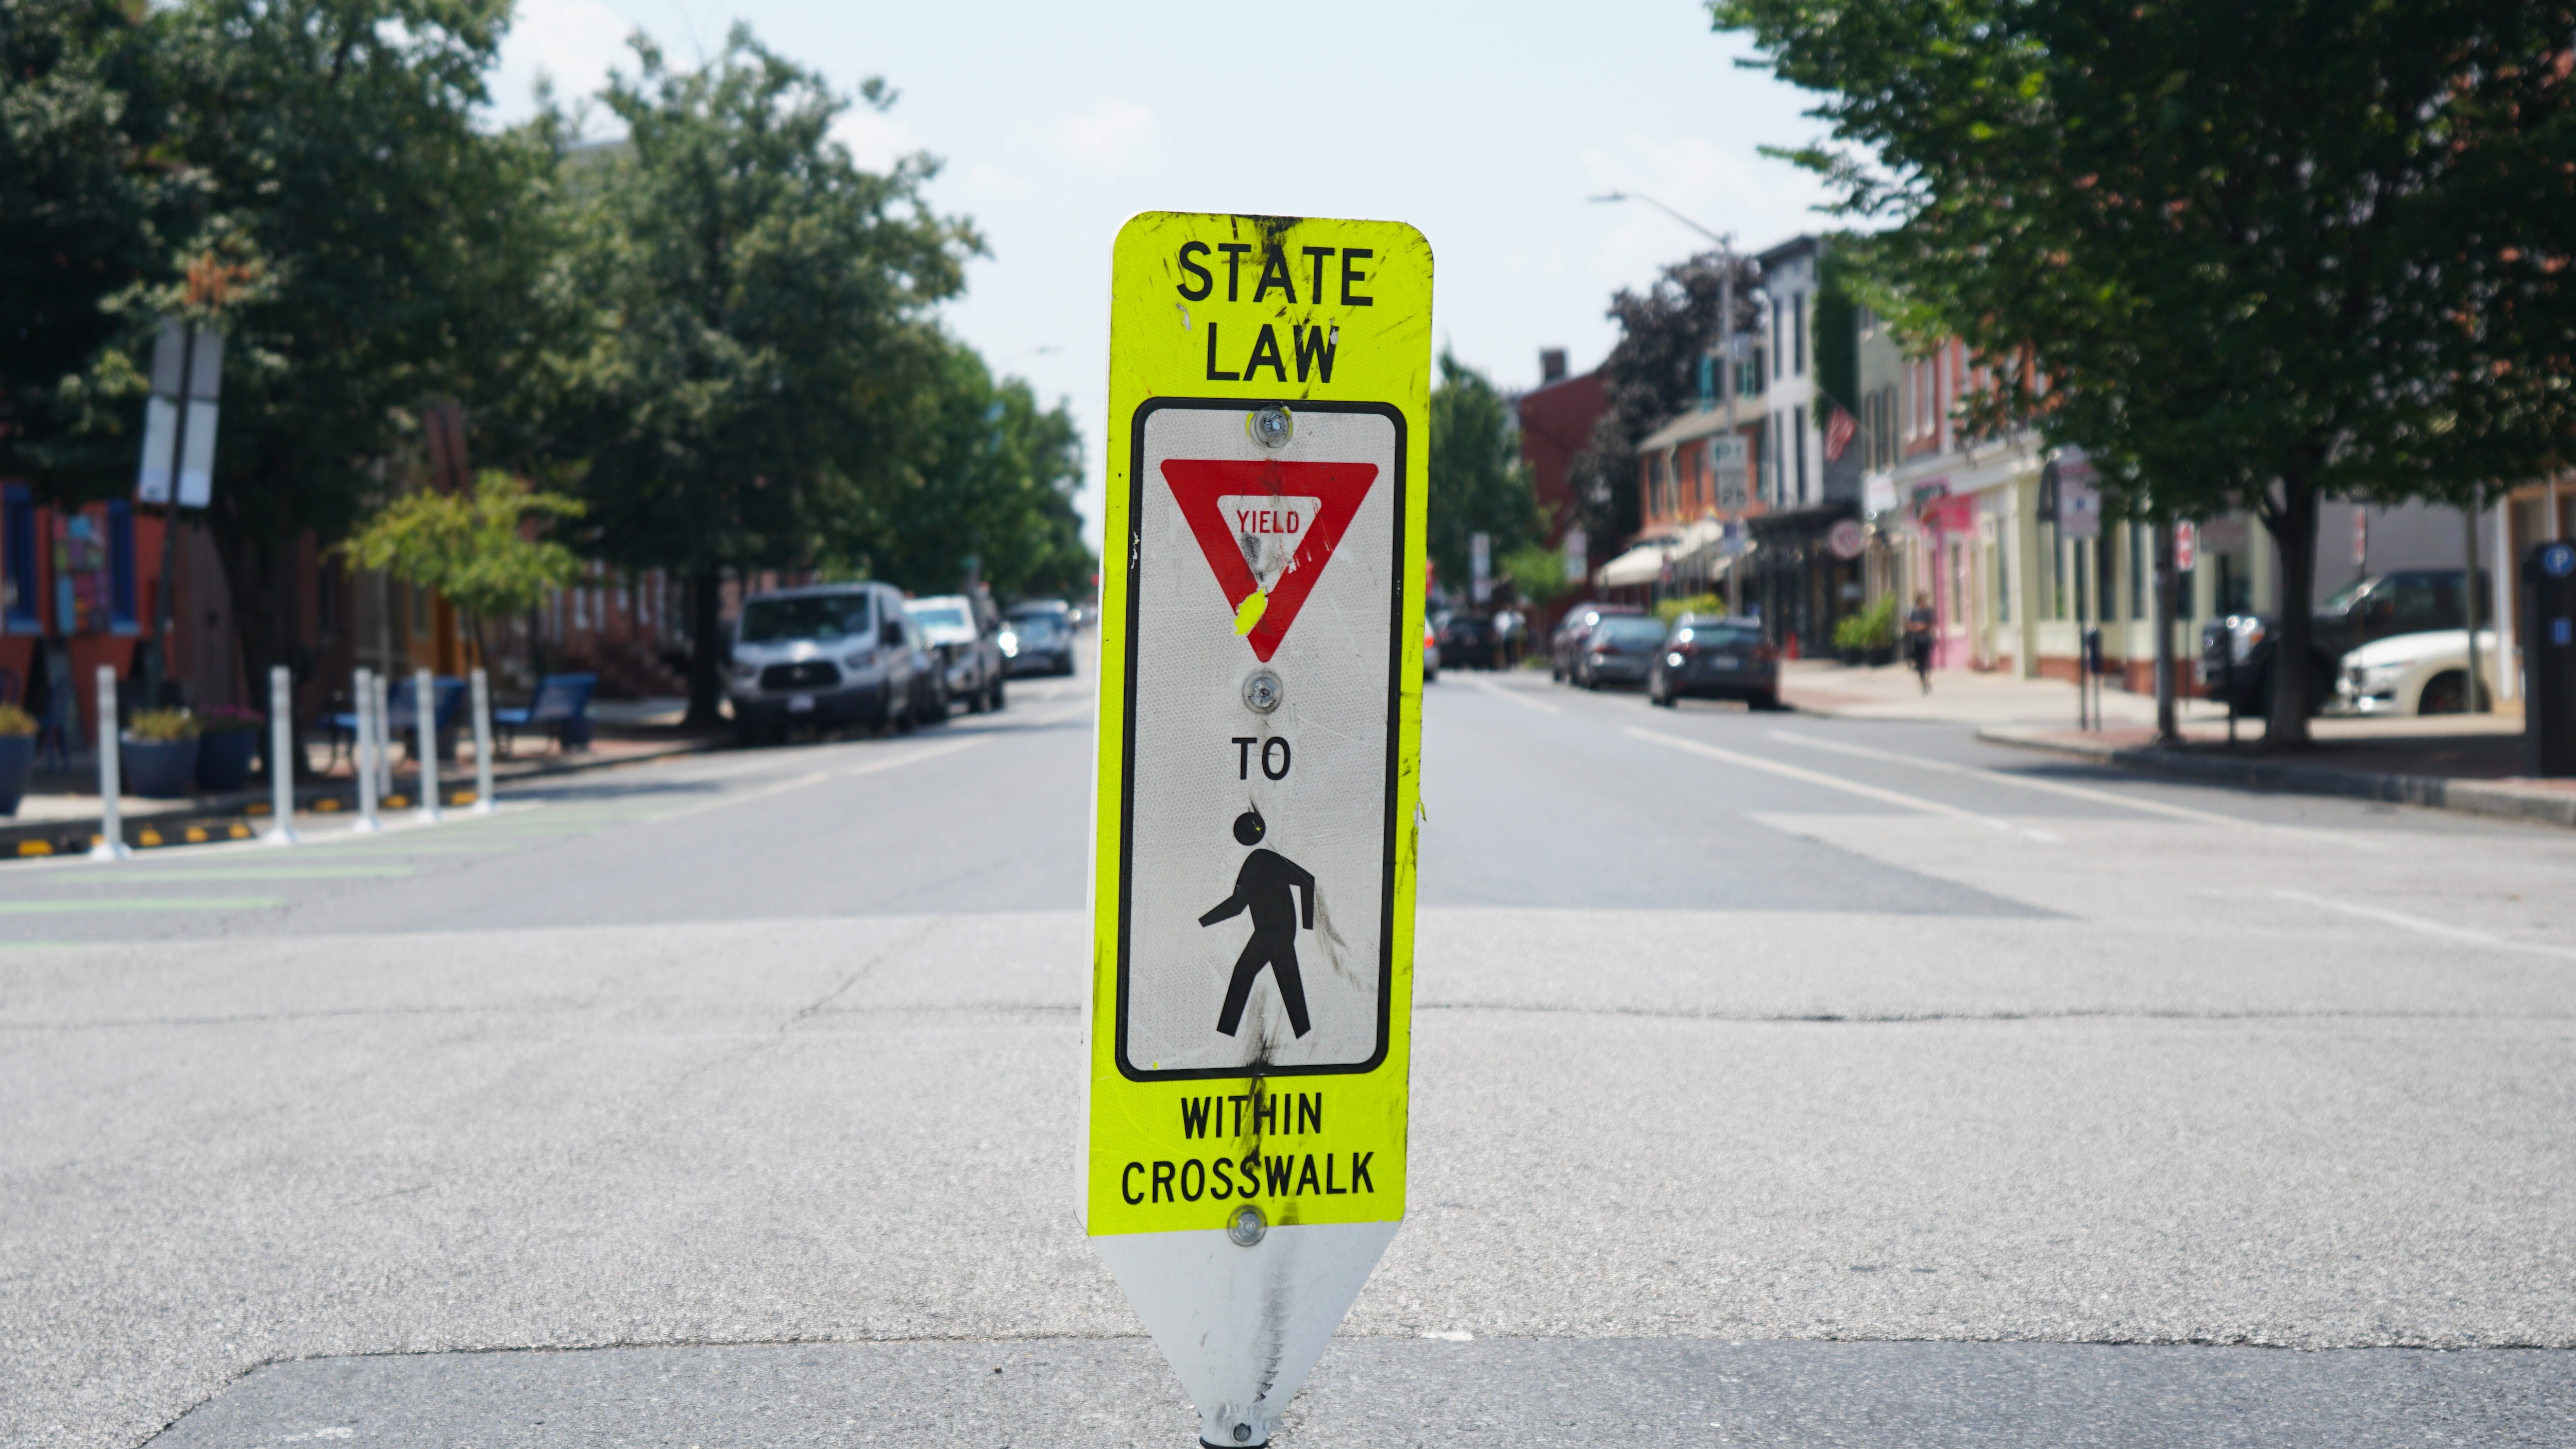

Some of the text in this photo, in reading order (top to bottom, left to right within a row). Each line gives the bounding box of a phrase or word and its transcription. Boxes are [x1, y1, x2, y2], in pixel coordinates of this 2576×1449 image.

[1176, 241, 1374, 306] STATE
[1207, 322, 1340, 383] LAW
[1237, 510, 1299, 534] YIELD
[1232, 737, 1291, 780] TO
[1181, 1092, 1322, 1139] WITHIN
[1122, 1152, 1375, 1205] CROSSWALK
